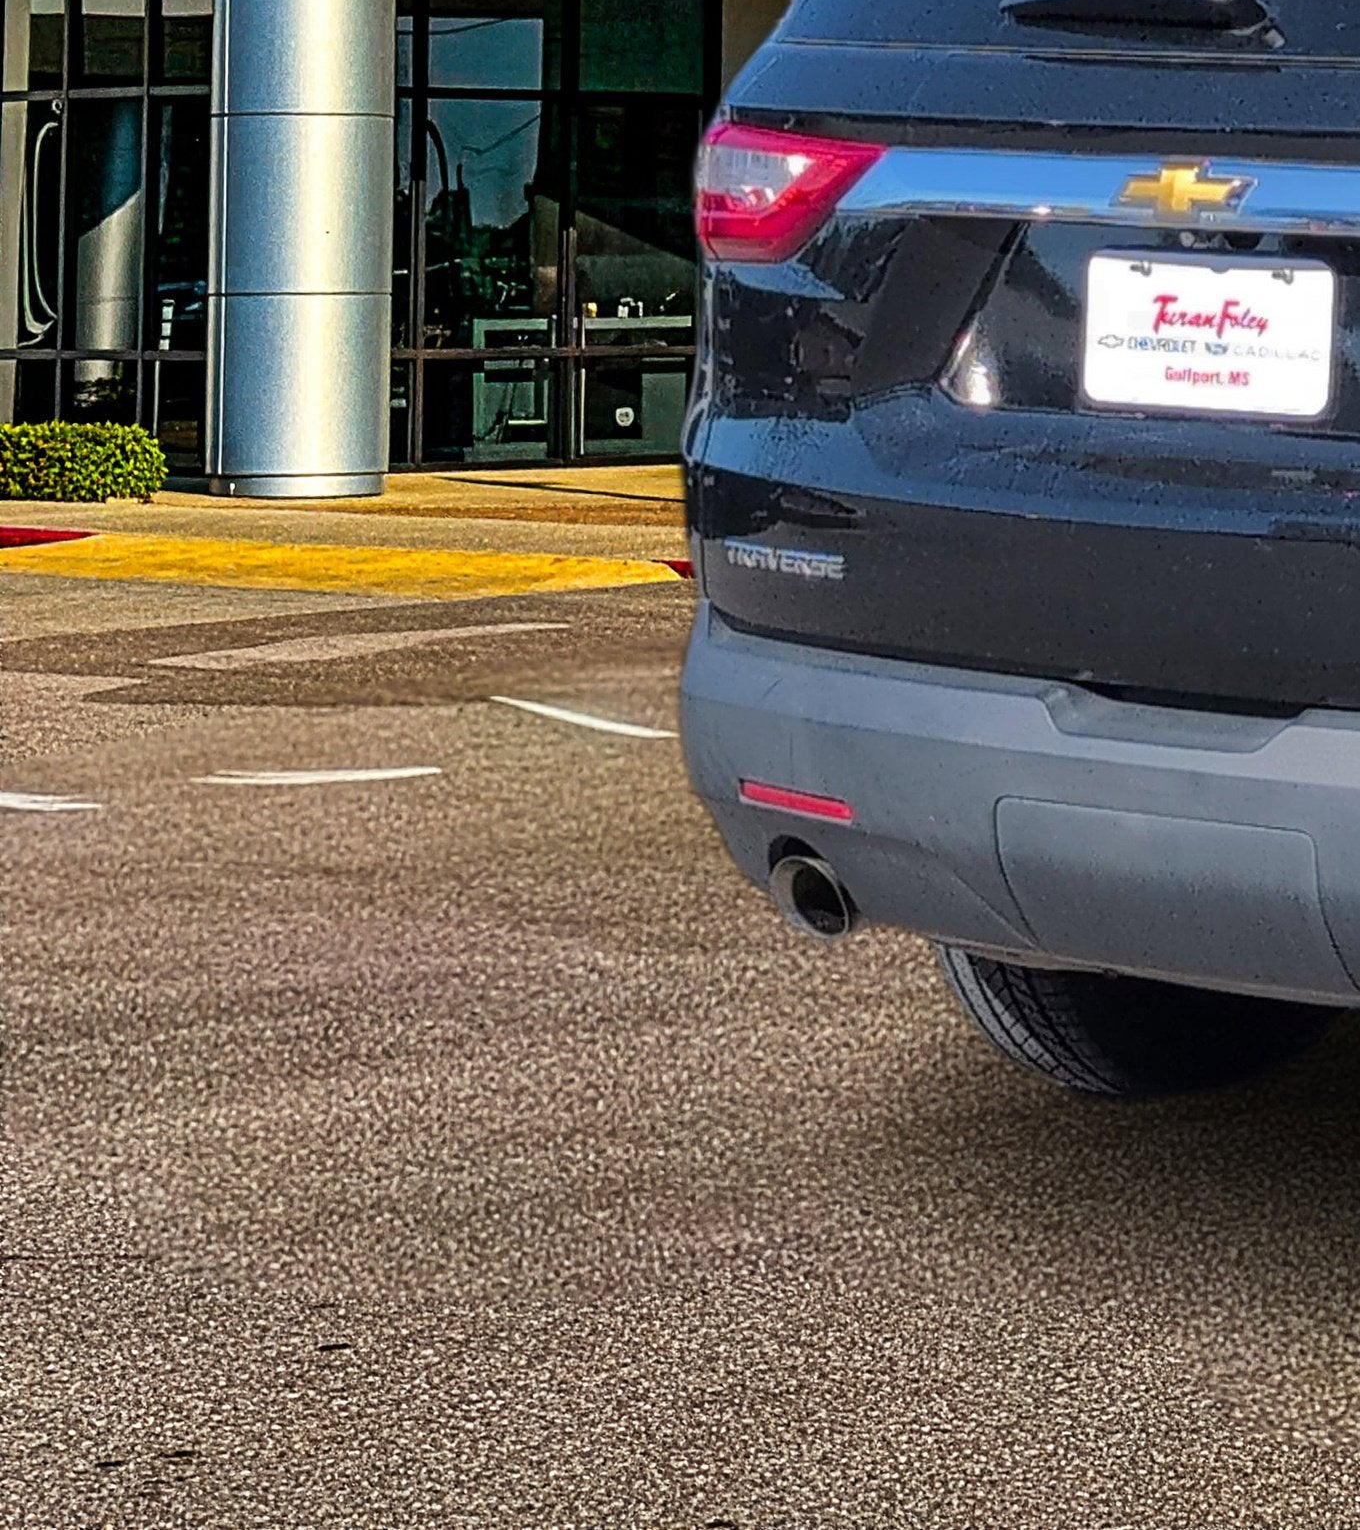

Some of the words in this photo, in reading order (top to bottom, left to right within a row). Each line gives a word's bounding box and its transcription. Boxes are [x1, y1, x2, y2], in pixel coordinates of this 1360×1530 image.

[1127, 336, 1197, 354] CHEVROLET
[1233, 346, 1321, 362] CADILLAC
[1227, 370, 1250, 387] MS
[723, 536, 845, 580] TRAVERSE
